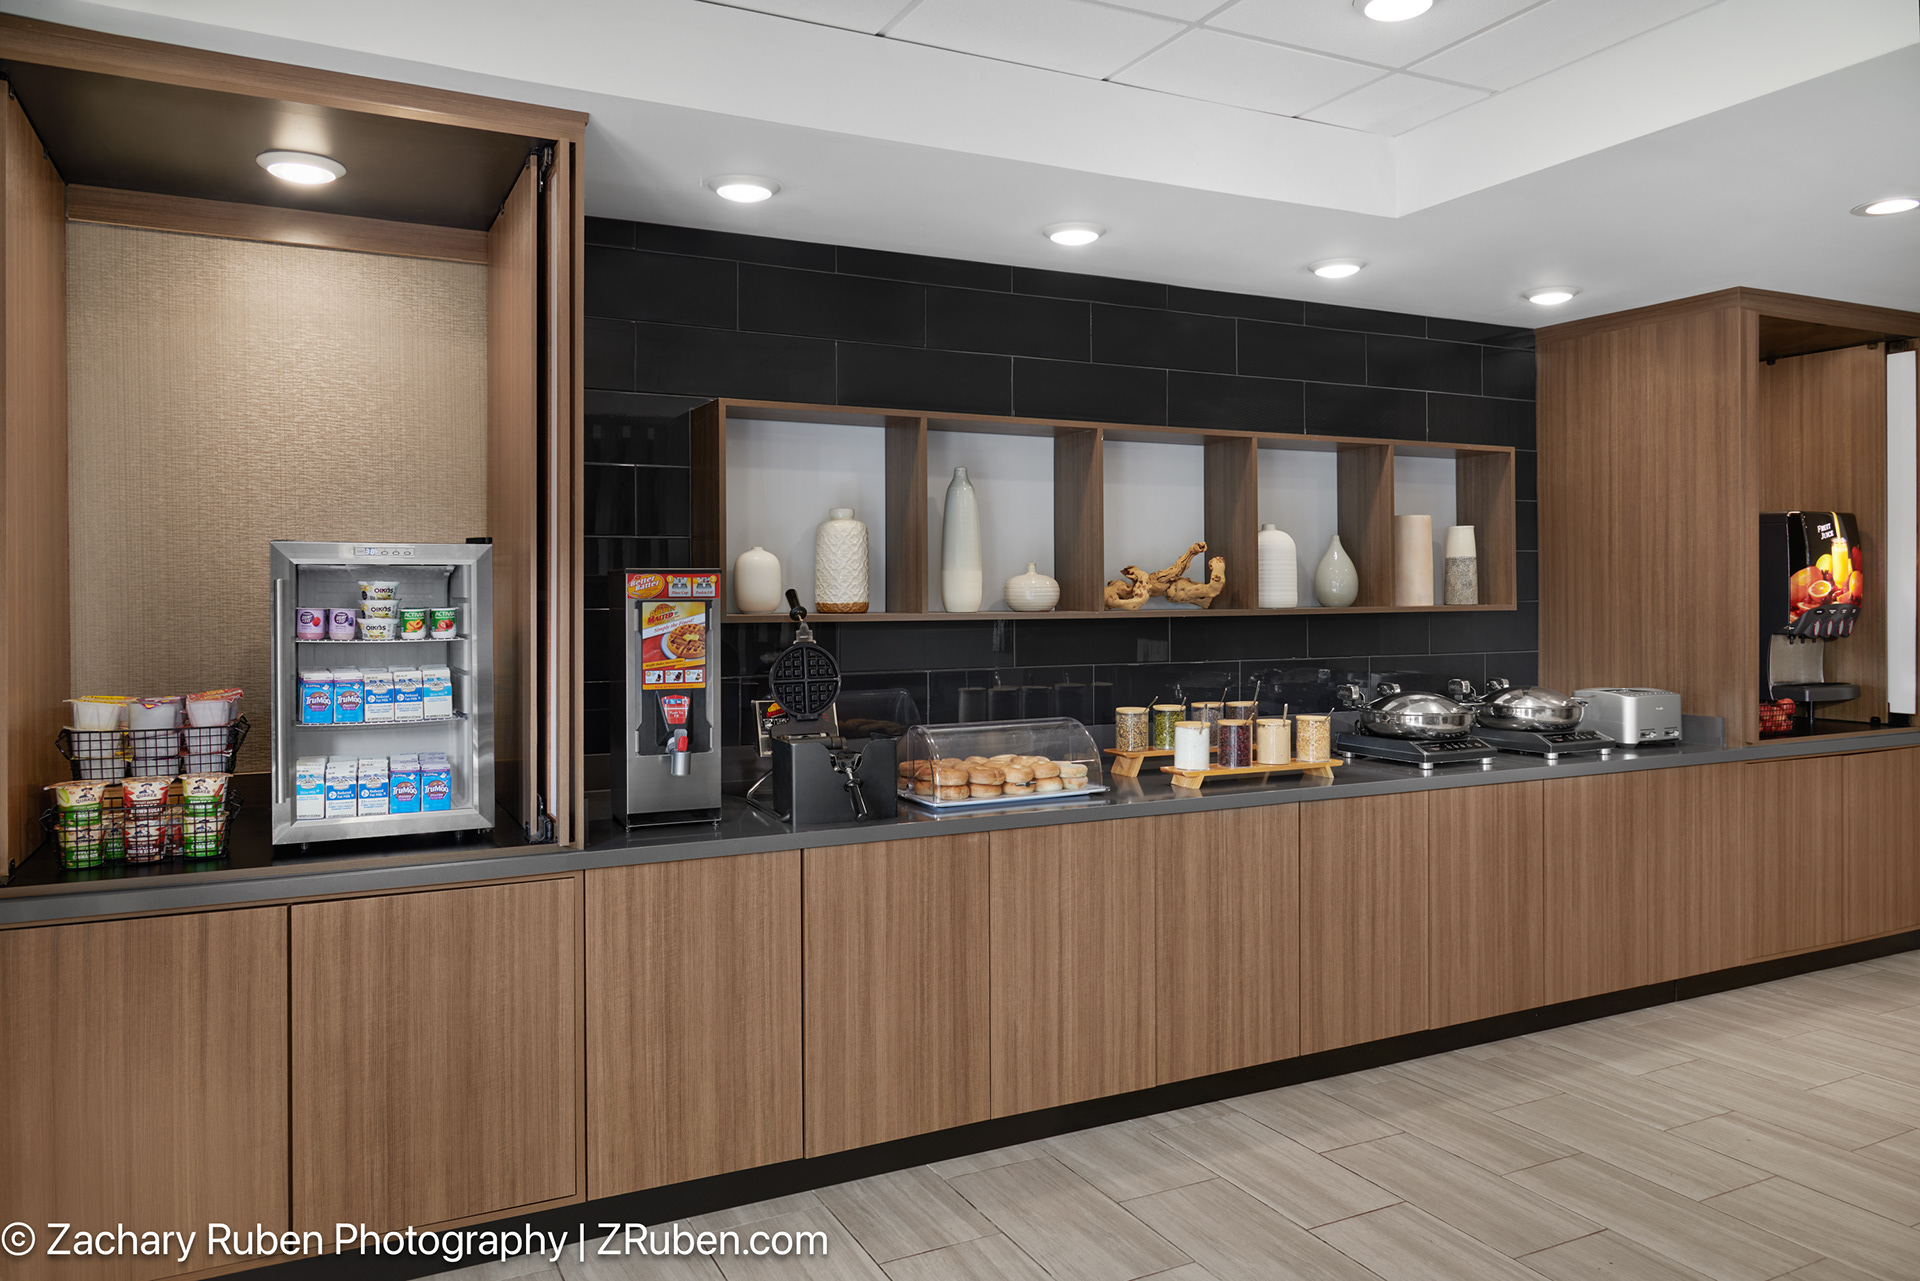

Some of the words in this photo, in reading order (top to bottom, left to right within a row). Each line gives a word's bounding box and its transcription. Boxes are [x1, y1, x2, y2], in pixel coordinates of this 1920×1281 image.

[630, 575, 655, 588] Better
[634, 579, 660, 592] Batter
[647, 612, 674, 624] MALTED
[306, 696, 331, 705] TruMoo
[337, 695, 362, 704] TruMoo
[392, 786, 418, 795] TruMoo
[424, 784, 449, 794] TruMoo
